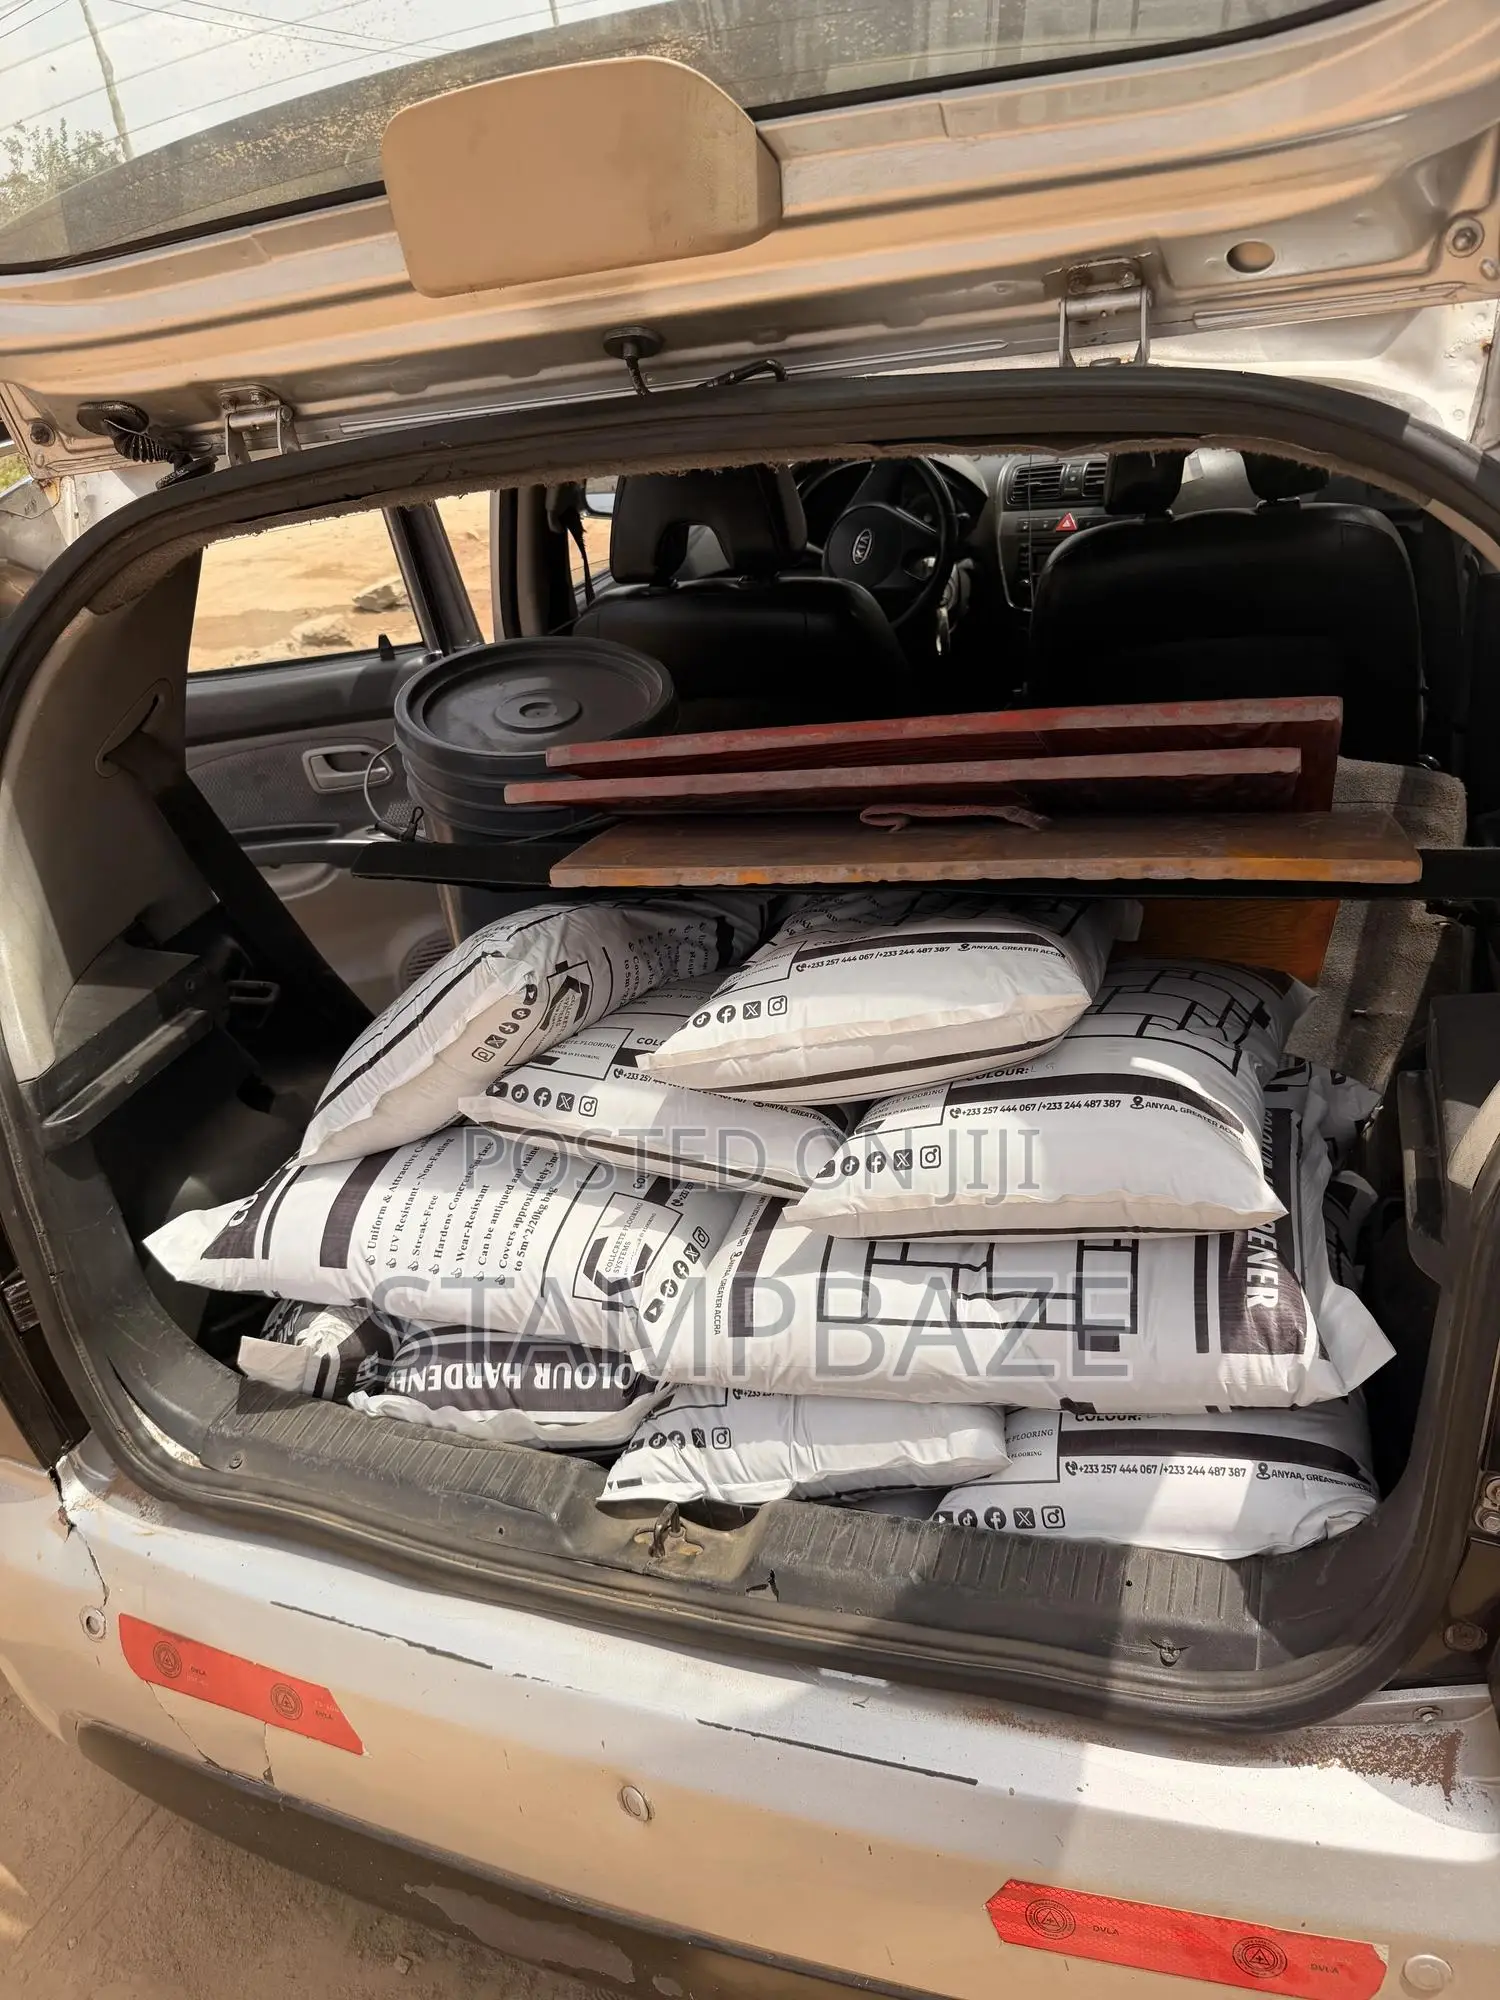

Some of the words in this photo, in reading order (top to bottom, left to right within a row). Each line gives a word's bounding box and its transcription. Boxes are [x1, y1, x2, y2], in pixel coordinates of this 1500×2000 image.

[825, 957, 840, 967] 257
[966, 1066, 1030, 1081] OLOUR:
[961, 1106, 981, 1116] +233
[983, 1105, 998, 1115] 257
[999, 1104, 1018, 1114] 444
[1019, 1103, 1036, 1112] 067
[1037, 1102, 1063, 1113] /+233
[1064, 1101, 1082, 1109] 244
[1083, 1100, 1102, 1109] 487
[1103, 1099, 1122, 1108] 387
[1145, 1101, 1178, 1113] ANYAA,
[1179, 1107, 1218, 1128] GREATER
[367, 1205, 387, 1250] Uniform
[382, 1193, 393, 1203] &
[389, 1152, 422, 1193] Attractive
[389, 1235, 401, 1252] UV
[395, 1186, 418, 1232] Resistant
[416, 1137, 455, 1180] Non-Fading
[433, 1211, 454, 1259] Hardens
[448, 1166, 475, 1211] Concrete
[468, 1141, 495, 1172] Surface
[477, 1246, 489, 1266] Can
[483, 1228, 493, 1245] be
[491, 1184, 515, 1228] antiqued
[511, 1167, 525, 1183] and
[522, 1145, 541, 1168] staine
[411, 1194, 439, 1257] Streak-Free
[455, 1183, 490, 1263] Wear-Resistant
[499, 1229, 517, 1269] Covers
[513, 1168, 551, 1229] approximately
[514, 1259, 523, 1272] to
[542, 1186, 559, 1205] bag
[605, 1230, 626, 1273] COLLCRETE
[623, 1202, 643, 1231] FLOORING
[613, 1241, 631, 1273] SYSTEMS
[715, 1279, 727, 1309] GREATER
[713, 1309, 722, 1335] ACCRA
[391, 1361, 522, 1393] HARDENE
[534, 1361, 635, 1391] OLOUR
[1012, 1429, 1053, 1442] FLOORING
[1079, 1463, 1099, 1474] +233
[1101, 1463, 1118, 1474] 257
[1119, 1464, 1139, 1475] 444
[1140, 1463, 1158, 1475] 067
[1159, 1464, 1185, 1477] /+233
[1186, 1465, 1206, 1477] 244
[1208, 1465, 1226, 1477] 487
[1228, 1465, 1247, 1478] 387
[1271, 1469, 1304, 1482] ANYAA,
[1092, 1924, 1120, 1936] DVLA
[1310, 1963, 1340, 1975] DVLA
